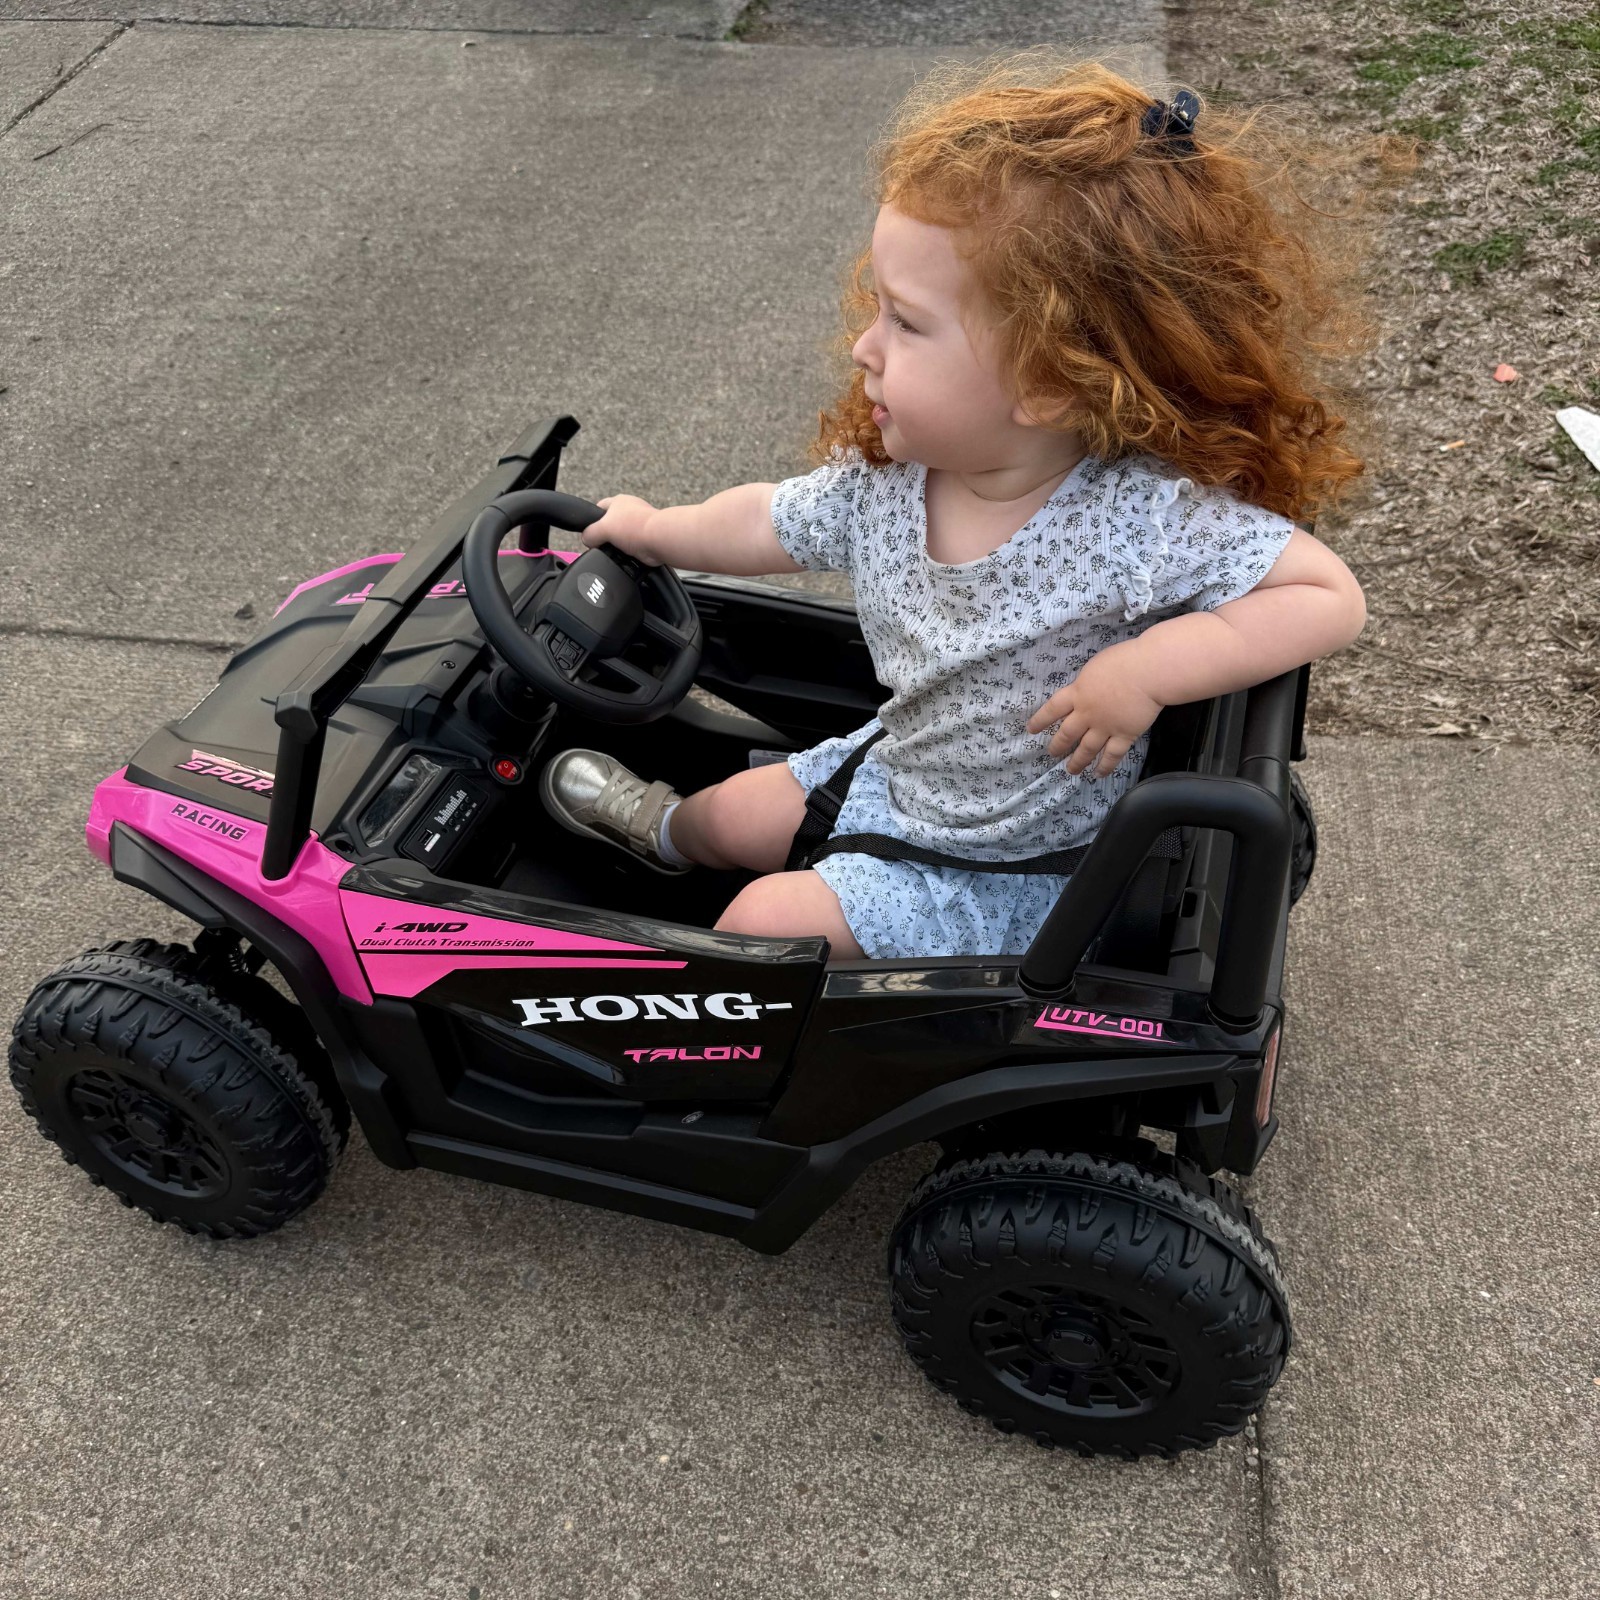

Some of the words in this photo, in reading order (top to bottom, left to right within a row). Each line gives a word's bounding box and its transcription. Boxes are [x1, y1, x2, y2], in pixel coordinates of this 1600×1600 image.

[586, 578, 605, 604] HM
[178, 760, 274, 795] SPOR
[171, 804, 246, 839] RACING
[373, 922, 468, 933] i-4WD
[360, 938, 393, 946] Dual
[394, 938, 437, 946] Clutch
[440, 938, 535, 947] Transmission
[511, 992, 793, 1026] HONG-
[1050, 1007, 1163, 1037] UTV-001
[623, 1046, 762, 1063] TALON
